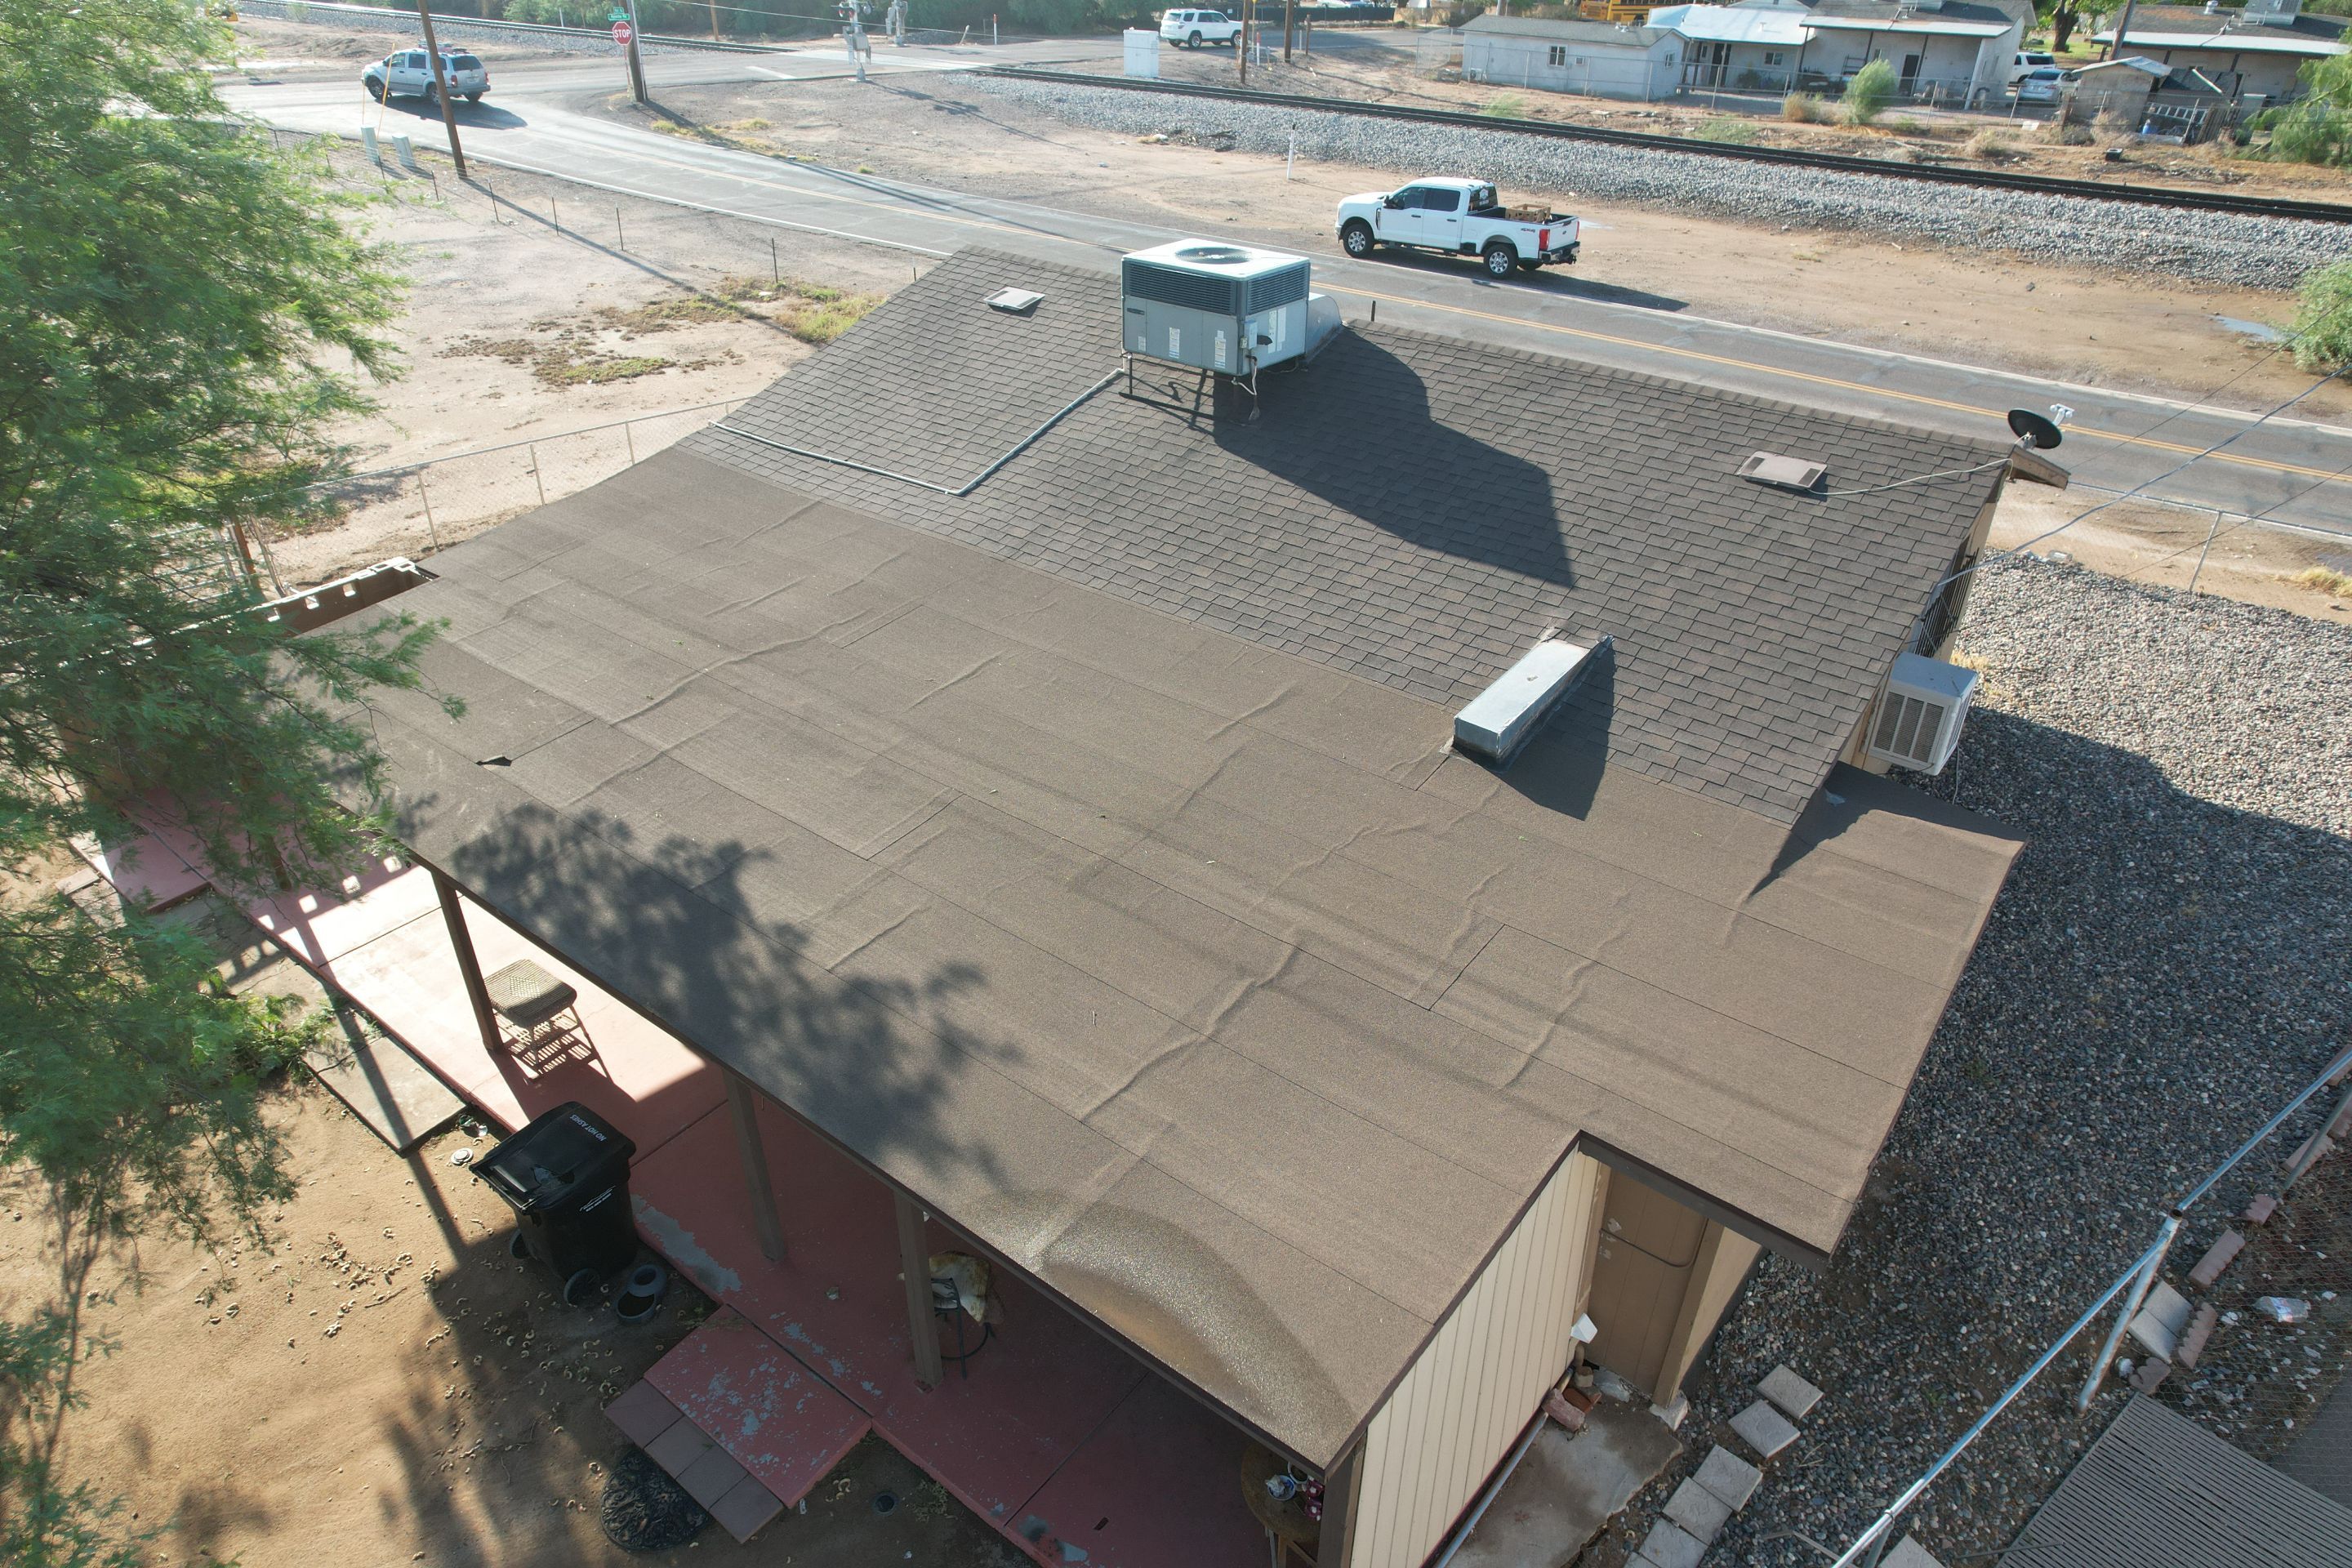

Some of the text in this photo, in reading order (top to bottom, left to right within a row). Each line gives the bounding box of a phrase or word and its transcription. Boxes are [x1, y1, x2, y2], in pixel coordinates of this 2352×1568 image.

[614, 29, 630, 38] STOP
[570, 1114, 607, 1142] NO HOT ASHES
